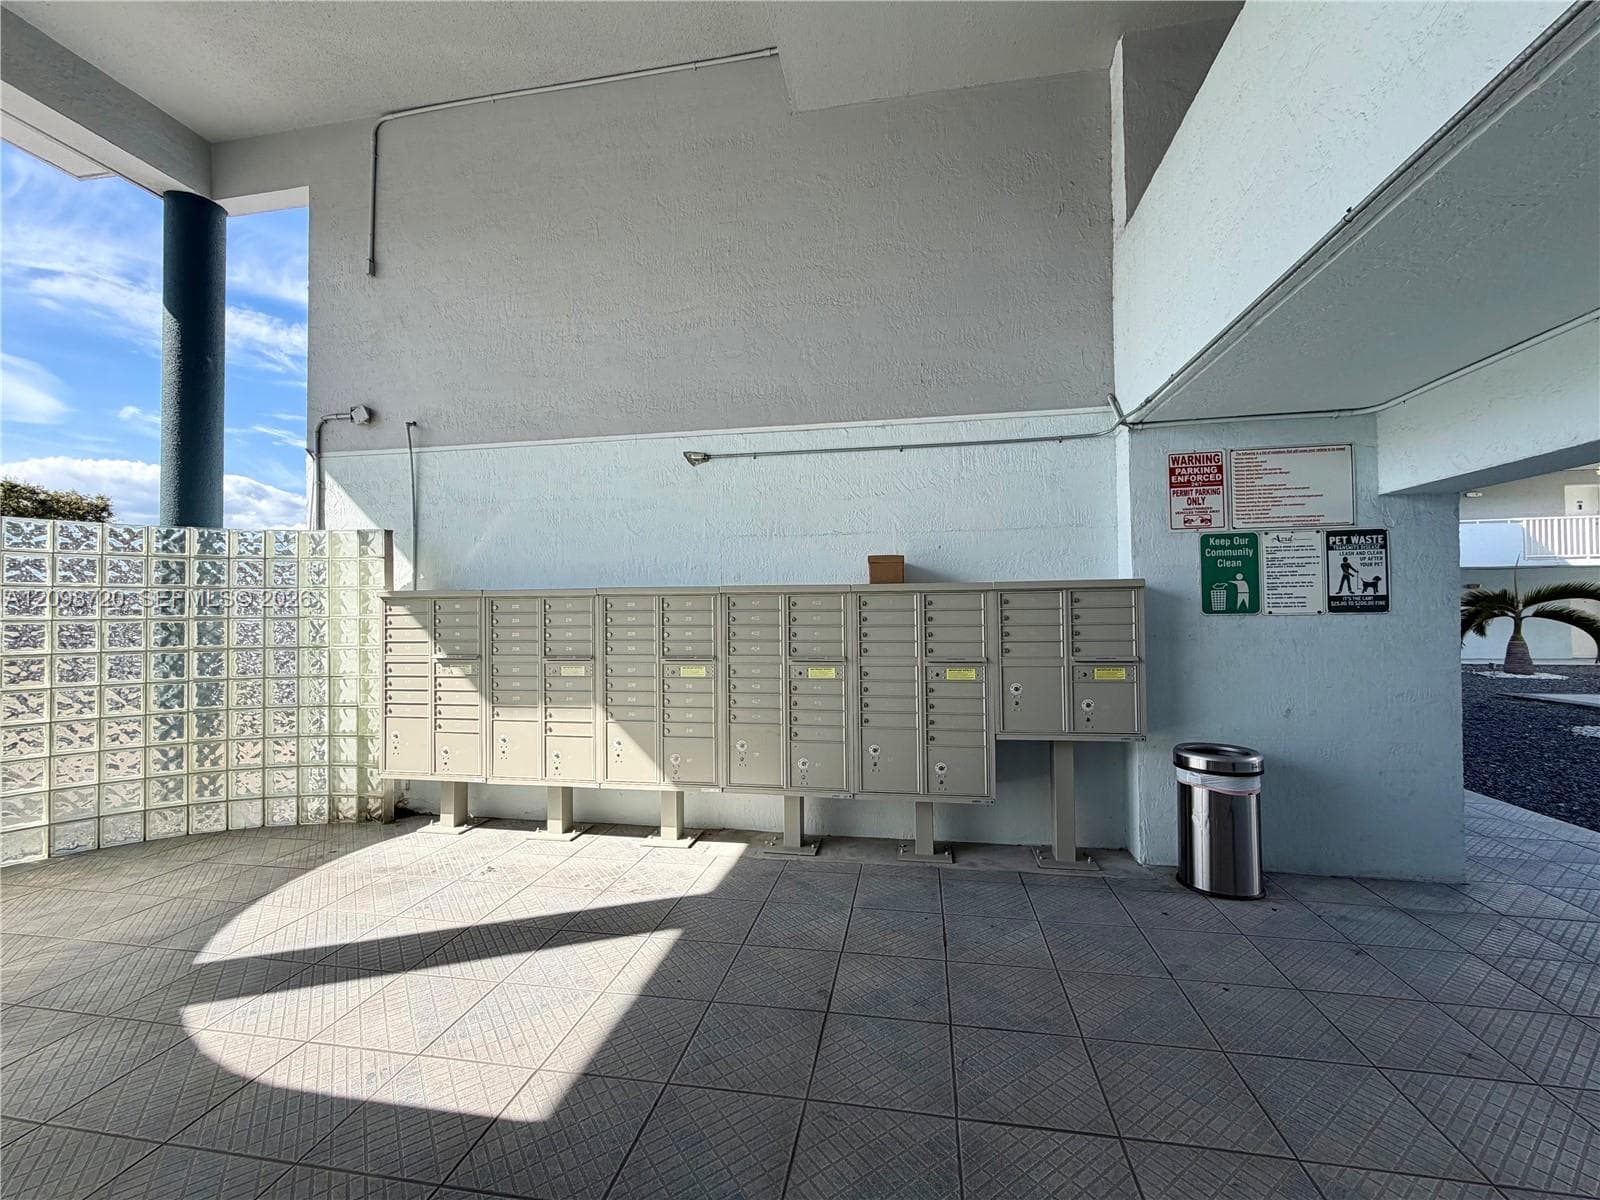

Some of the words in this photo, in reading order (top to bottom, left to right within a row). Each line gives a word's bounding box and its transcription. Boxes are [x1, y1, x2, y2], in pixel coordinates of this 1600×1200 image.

[1171, 454, 1221, 466] WARNING
[1175, 466, 1218, 475] PARKING
[1171, 474, 1222, 483] ENFORCED
[1172, 489, 1194, 498] PERMIT
[1194, 488, 1221, 497] PARKING
[1186, 496, 1206, 506] ONLY
[1209, 537, 1231, 547] Keep
[1233, 536, 1249, 545] Our
[1329, 536, 1347, 545] PET
[1350, 534, 1385, 544] WASTE
[1205, 547, 1254, 558] Community
[1217, 559, 1242, 568] Clean
